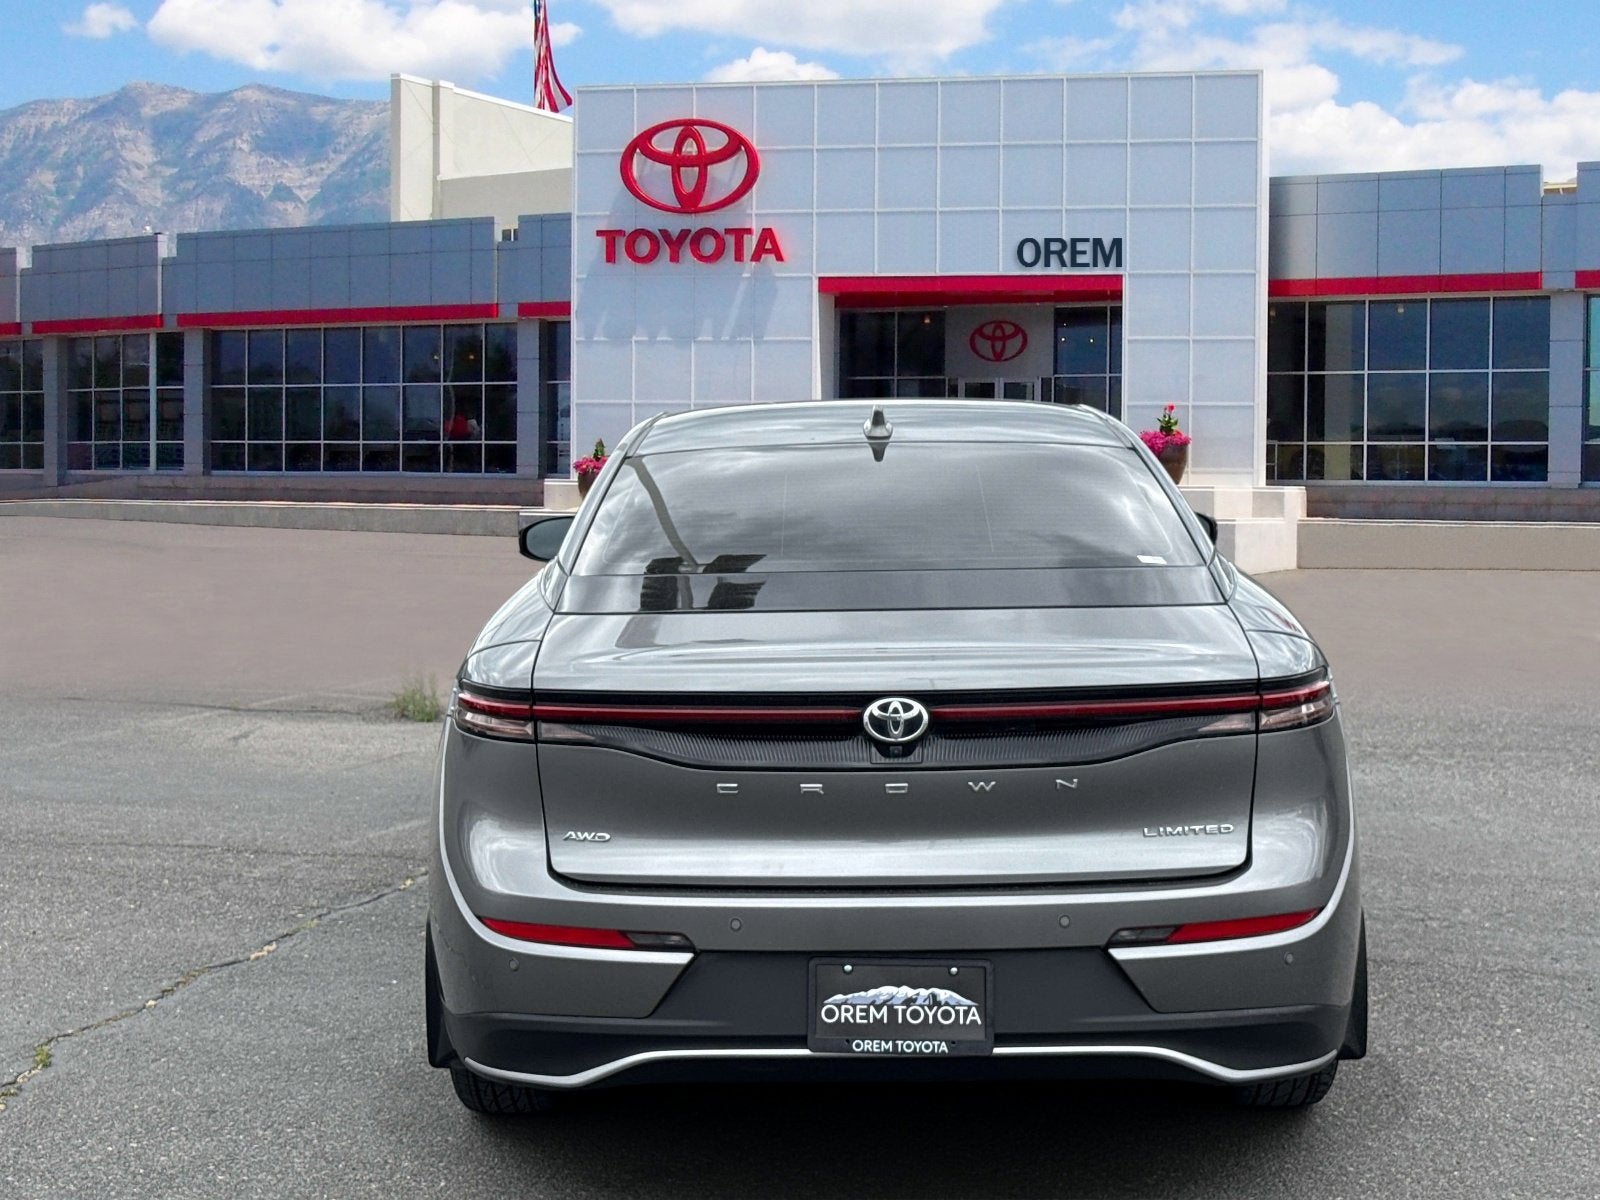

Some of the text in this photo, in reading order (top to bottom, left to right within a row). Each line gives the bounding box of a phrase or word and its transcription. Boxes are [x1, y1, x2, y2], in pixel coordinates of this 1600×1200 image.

[596, 227, 785, 265] TOYOTA
[1016, 237, 1123, 268] OREM
[716, 778, 1079, 794] CROWN
[562, 830, 612, 842] AWD
[1143, 823, 1235, 838] LIMITED
[821, 1004, 982, 1025] OREM TOYOTA
[852, 1039, 949, 1054] OREM TOYOTA
